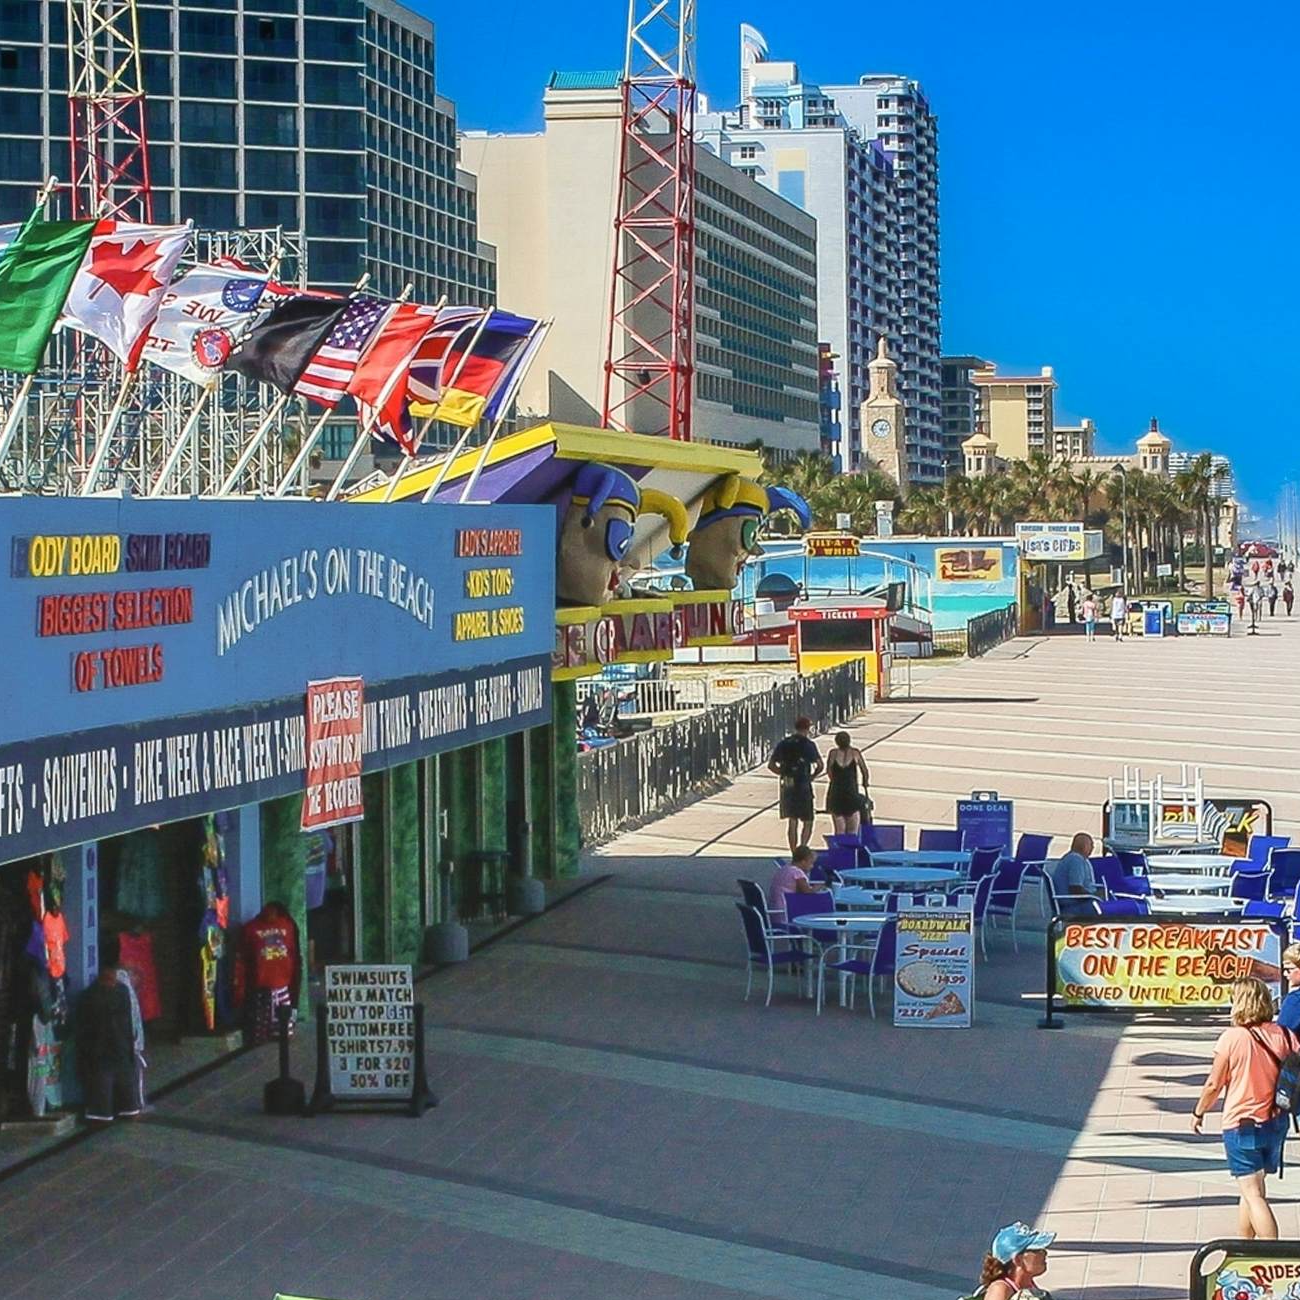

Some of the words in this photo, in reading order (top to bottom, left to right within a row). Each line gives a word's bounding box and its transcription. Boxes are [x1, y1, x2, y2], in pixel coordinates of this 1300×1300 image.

[68, 533, 121, 576] BOARD
[823, 547, 859, 555] WHIRL
[216, 549, 318, 656] MICHAEL'S
[324, 546, 352, 595] ON
[357, 549, 384, 598] THE
[388, 558, 436, 631] BEACH
[39, 593, 110, 637] BIGGEST
[114, 586, 193, 631] SELECTION
[821, 610, 859, 619] TICKETS
[455, 611, 490, 641] APPAREL
[498, 607, 524, 635] SHOES
[74, 650, 100, 692] OF
[102, 644, 163, 689] TOWELS
[313, 690, 360, 724] PLEASE
[43, 747, 117, 828] SOUVENIRS
[134, 738, 164, 805] BIKE
[166, 733, 199, 798] WEEK
[202, 730, 211, 792] &
[213, 727, 242, 788] RACE
[243, 721, 273, 783] WEEK
[900, 919, 967, 931] BOARDWALK
[1066, 926, 1124, 949] BEST
[1131, 926, 1269, 950] BREAKFAST
[900, 944, 966, 959] Special
[1083, 955, 1117, 977] ON
[1124, 955, 1170, 977] THE
[1175, 955, 1252, 978] BEACH
[332, 971, 407, 986] SWIMSUITS
[328, 988, 351, 1002] MIX
[366, 988, 412, 1002] MATCH
[1066, 984, 1123, 1000] SERVED
[1129, 984, 1173, 1001] UNTIL
[1180, 985, 1223, 1001] 12:00
[332, 1006, 356, 1019] BUY
[361, 1006, 384, 1019] TOP
[387, 1005, 413, 1020] GET
[340, 1057, 348, 1071] 3
[356, 1057, 381, 1071] FOR
[350, 1074, 379, 1088] 50%
[385, 1074, 410, 1088] OFF
